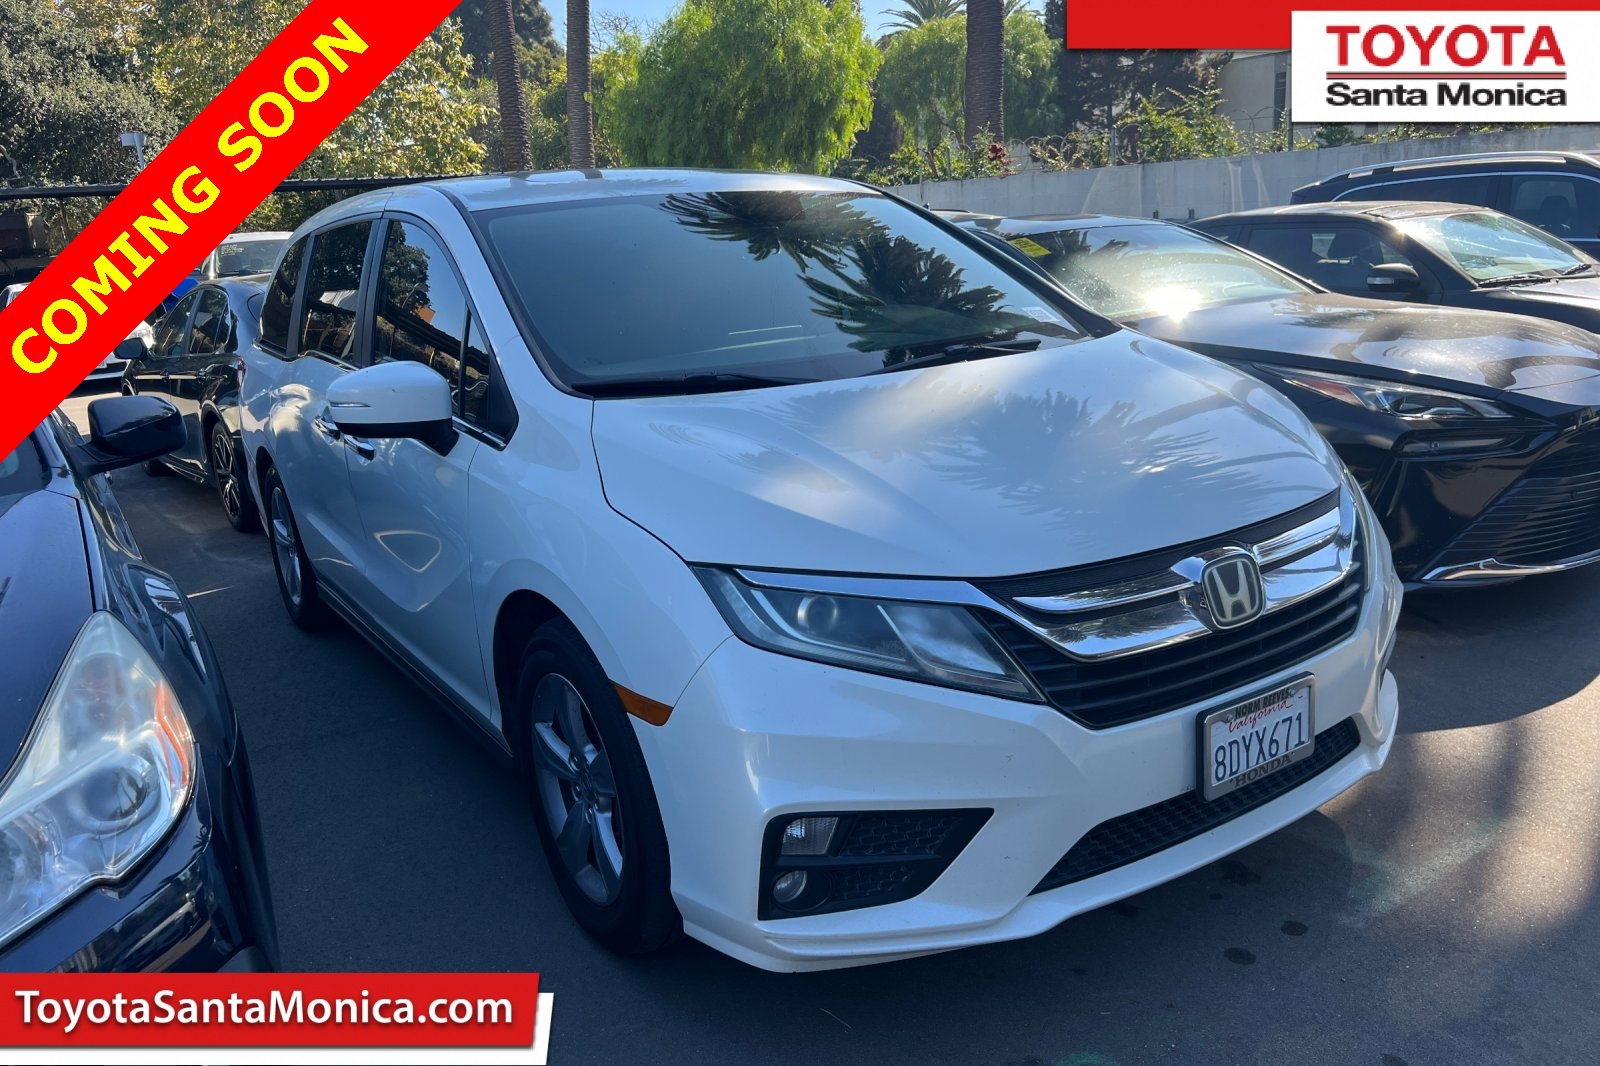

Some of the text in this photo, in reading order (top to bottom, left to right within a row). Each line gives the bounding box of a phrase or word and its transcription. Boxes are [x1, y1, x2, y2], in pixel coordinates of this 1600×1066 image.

[1227, 700, 1293, 733] California
[1234, 688, 1290, 719] NORM REEVES
[1214, 711, 1306, 782] 8DYX671
[1233, 754, 1291, 788] HONDA
